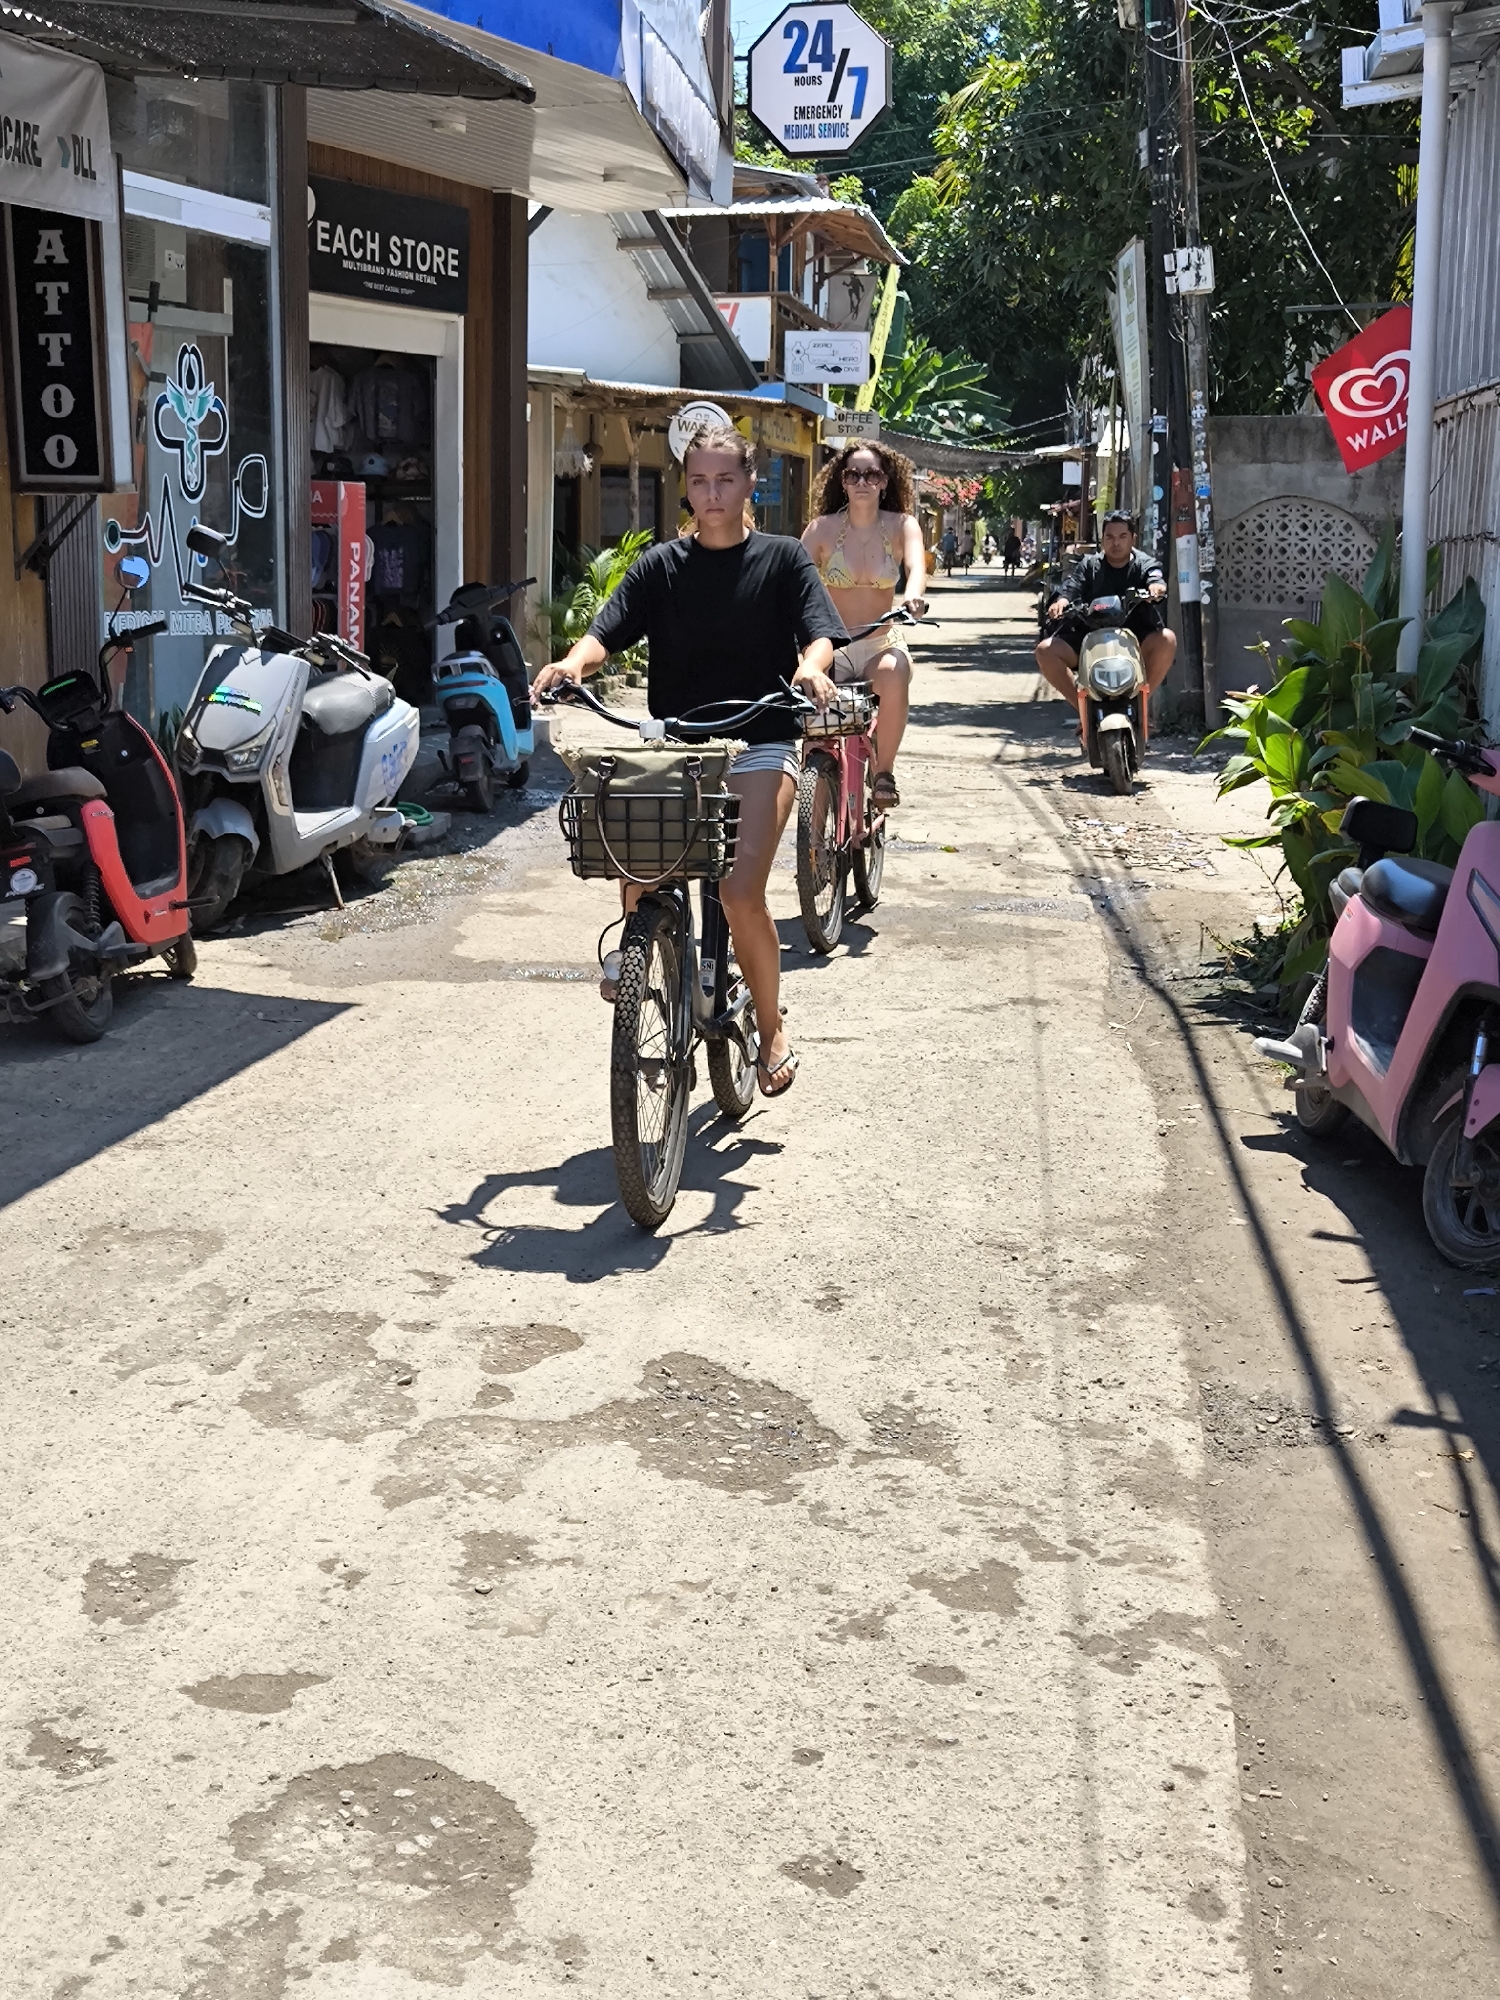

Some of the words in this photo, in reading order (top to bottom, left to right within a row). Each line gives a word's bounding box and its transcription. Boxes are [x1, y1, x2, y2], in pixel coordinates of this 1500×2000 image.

[794, 75, 823, 87] HOURS
[793, 104, 843, 120] EMERGENCY
[0, 115, 42, 168] CARE
[784, 124, 816, 140] MEDICAL
[818, 122, 850, 139] SERVICE
[71, 133, 97, 181] DLL
[342, 258, 385, 275] MULTIBRAND
[386, 268, 414, 281] FASHION
[415, 272, 437, 285] RETAIL
[389, 234, 460, 278] STORE
[33, 228, 79, 469] ATTOO
[837, 423, 864, 434] STOP
[1346, 411, 1407, 453] WALL
[350, 542, 361, 650] PANAM
[170, 610, 214, 637] MITRA
